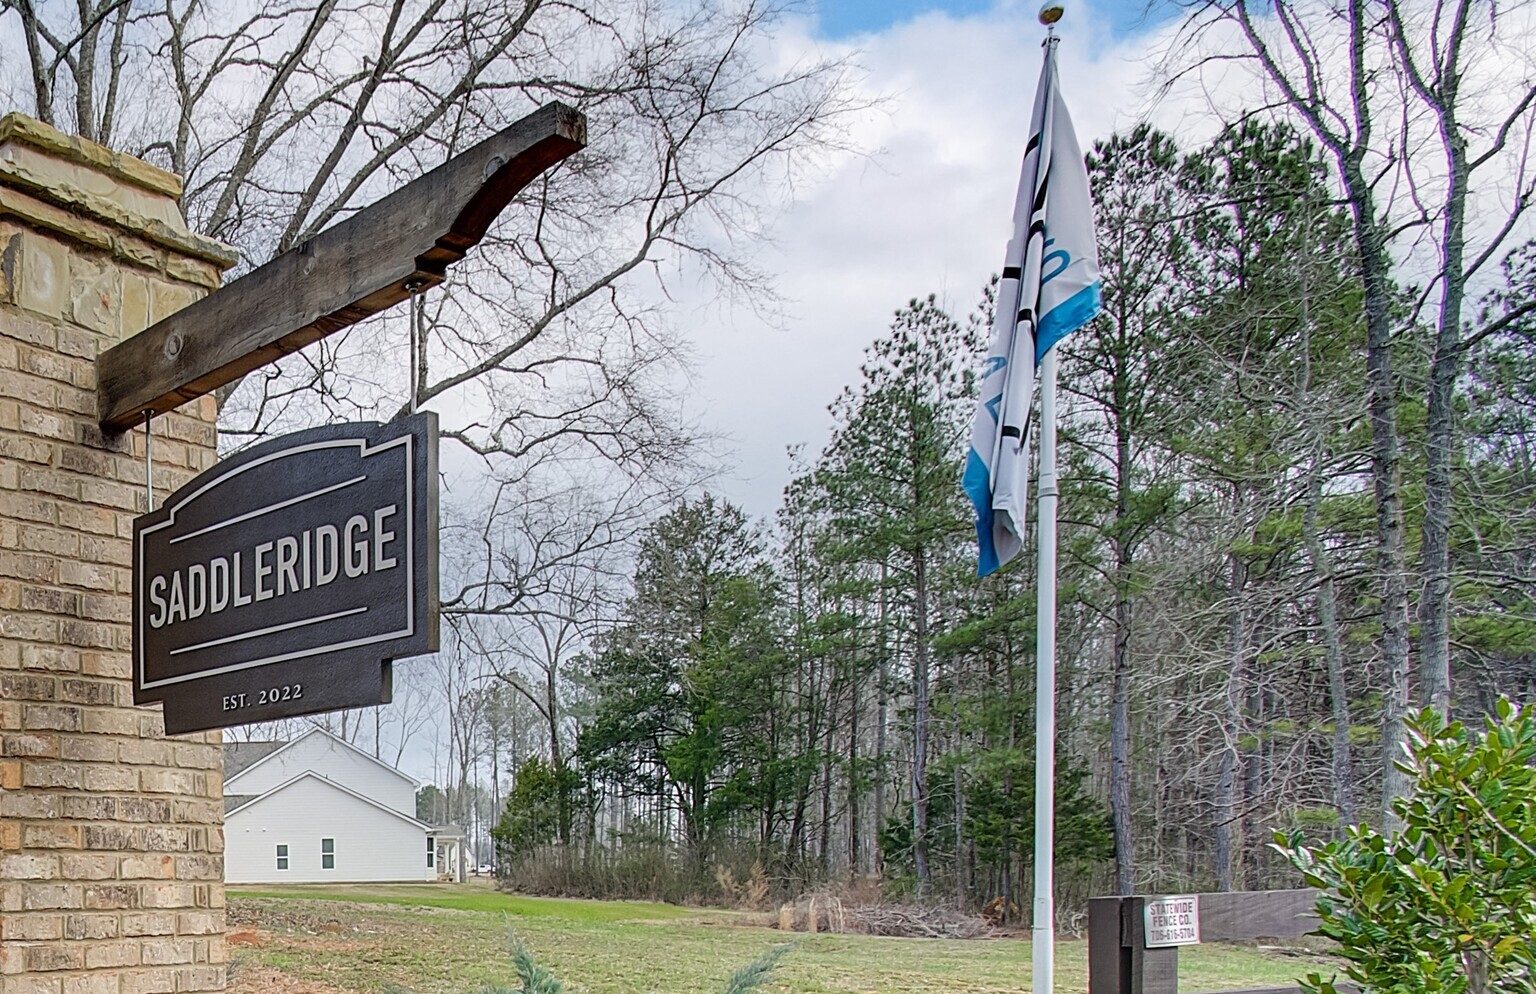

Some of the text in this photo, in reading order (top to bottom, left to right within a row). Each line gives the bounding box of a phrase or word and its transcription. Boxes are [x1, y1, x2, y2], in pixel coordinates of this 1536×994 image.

[149, 504, 398, 628] SADDLERIDGE
[223, 684, 302, 710] EST. 2022
[1150, 902, 1193, 915] STATEWIDE
[1153, 914, 1192, 927] FENCE CO.
